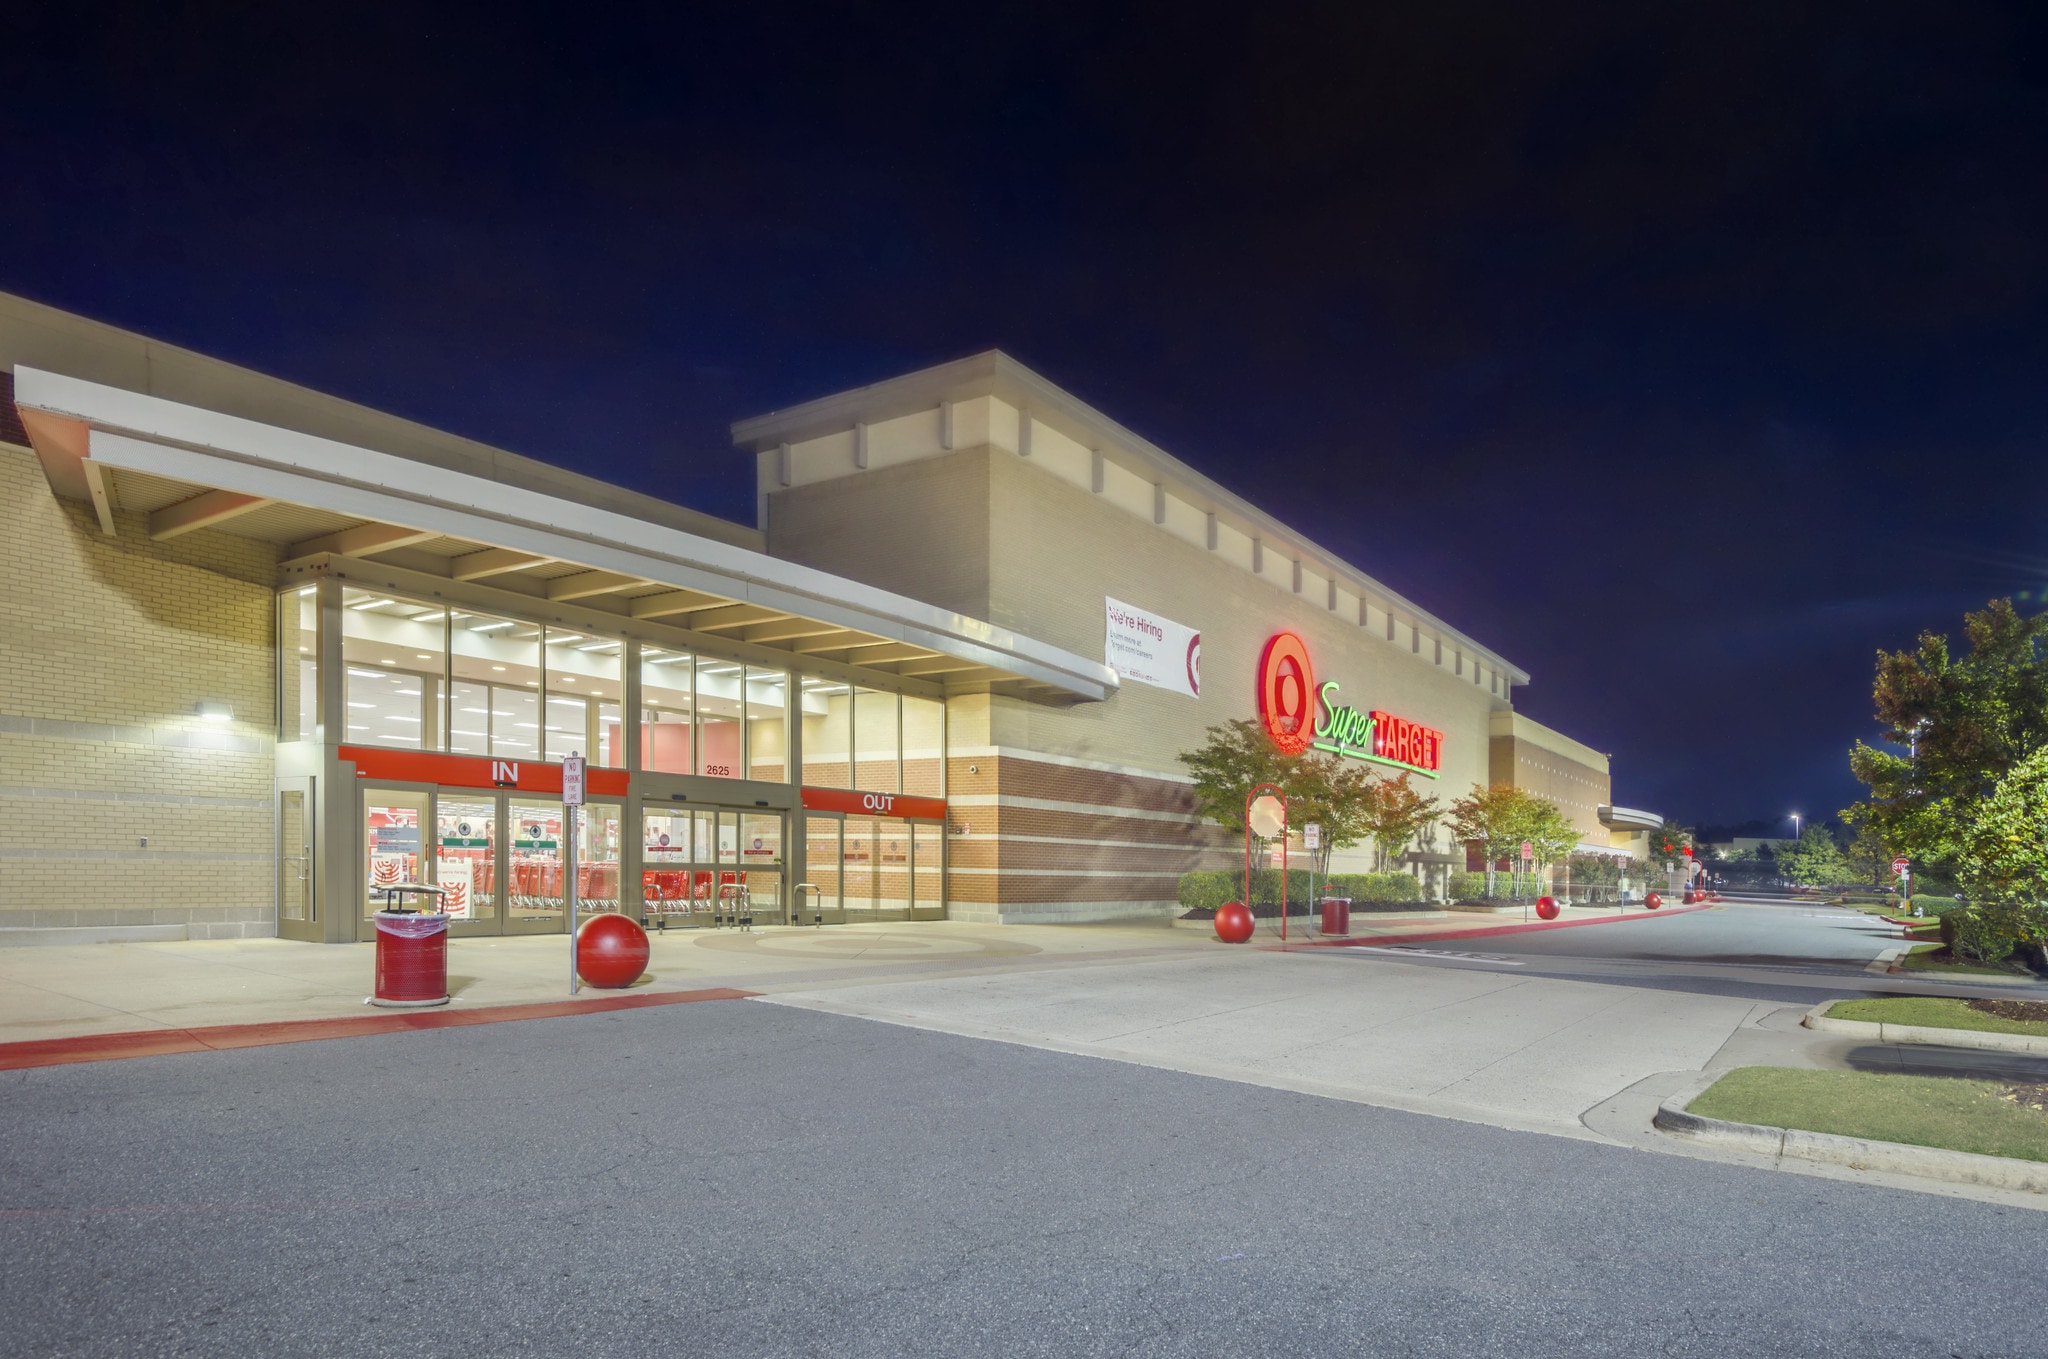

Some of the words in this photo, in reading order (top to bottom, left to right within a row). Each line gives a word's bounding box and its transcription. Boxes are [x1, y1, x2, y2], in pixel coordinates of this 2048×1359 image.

[1109, 606, 1135, 629] We're
[1137, 616, 1163, 642] Hiring
[1369, 709, 1445, 771] TARGET
[491, 760, 518, 782] IN
[568, 762, 577, 772] NO
[706, 764, 730, 776] 2625
[564, 774, 581, 784] PARKING
[863, 793, 894, 811] OUT
